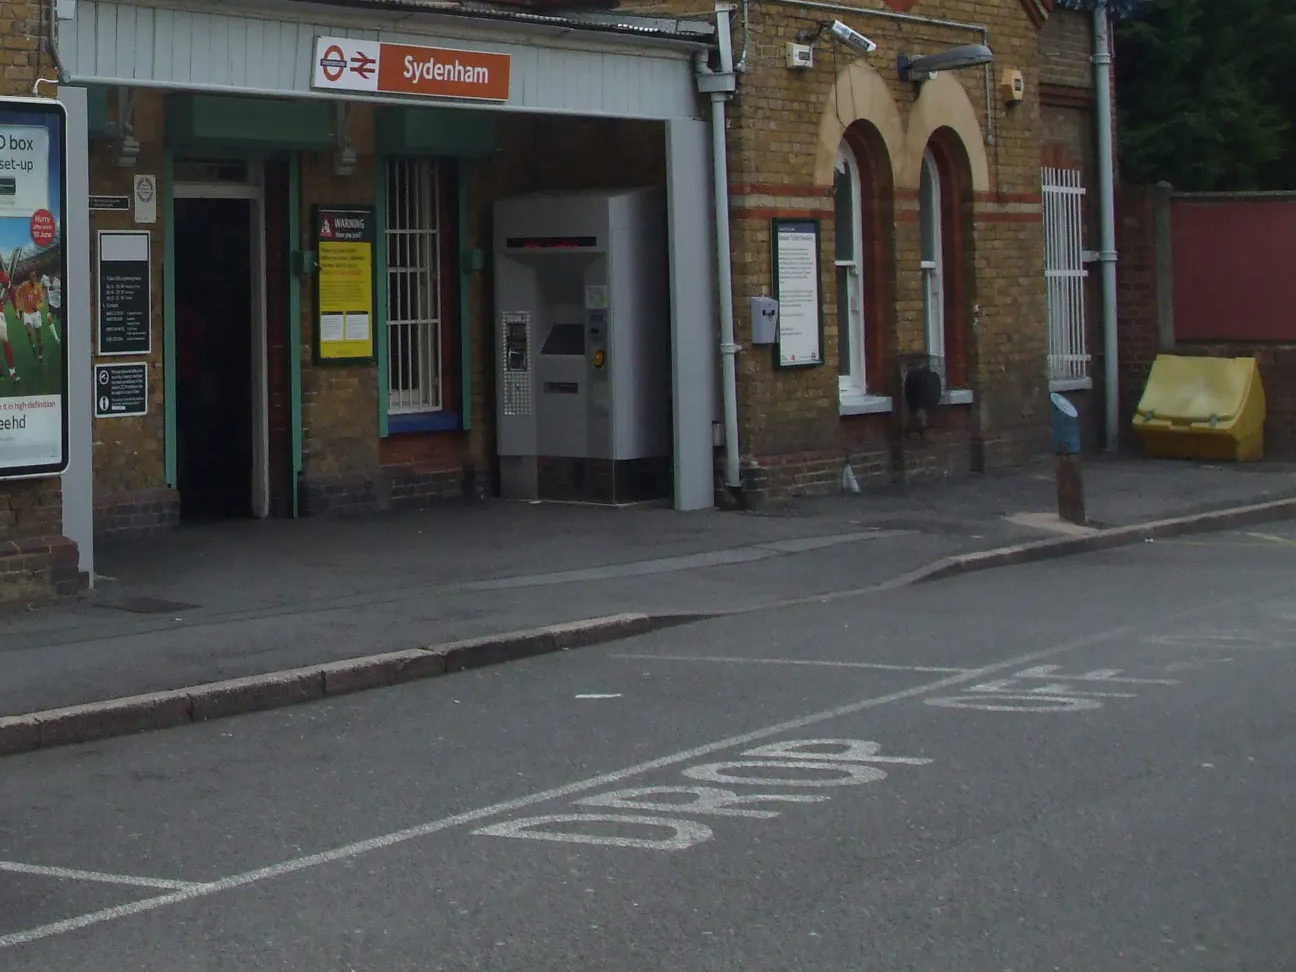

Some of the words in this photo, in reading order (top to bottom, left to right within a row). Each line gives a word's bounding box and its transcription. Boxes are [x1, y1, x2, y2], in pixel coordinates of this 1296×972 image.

[403, 55, 488, 84] Sydenham
[9, 136, 34, 150] box
[334, 218, 365, 229] WARNING
[14, 400, 27, 411] high
[27, 400, 56, 409] definition
[469, 737, 934, 851] DROP
[923, 664, 1181, 712] OFF
